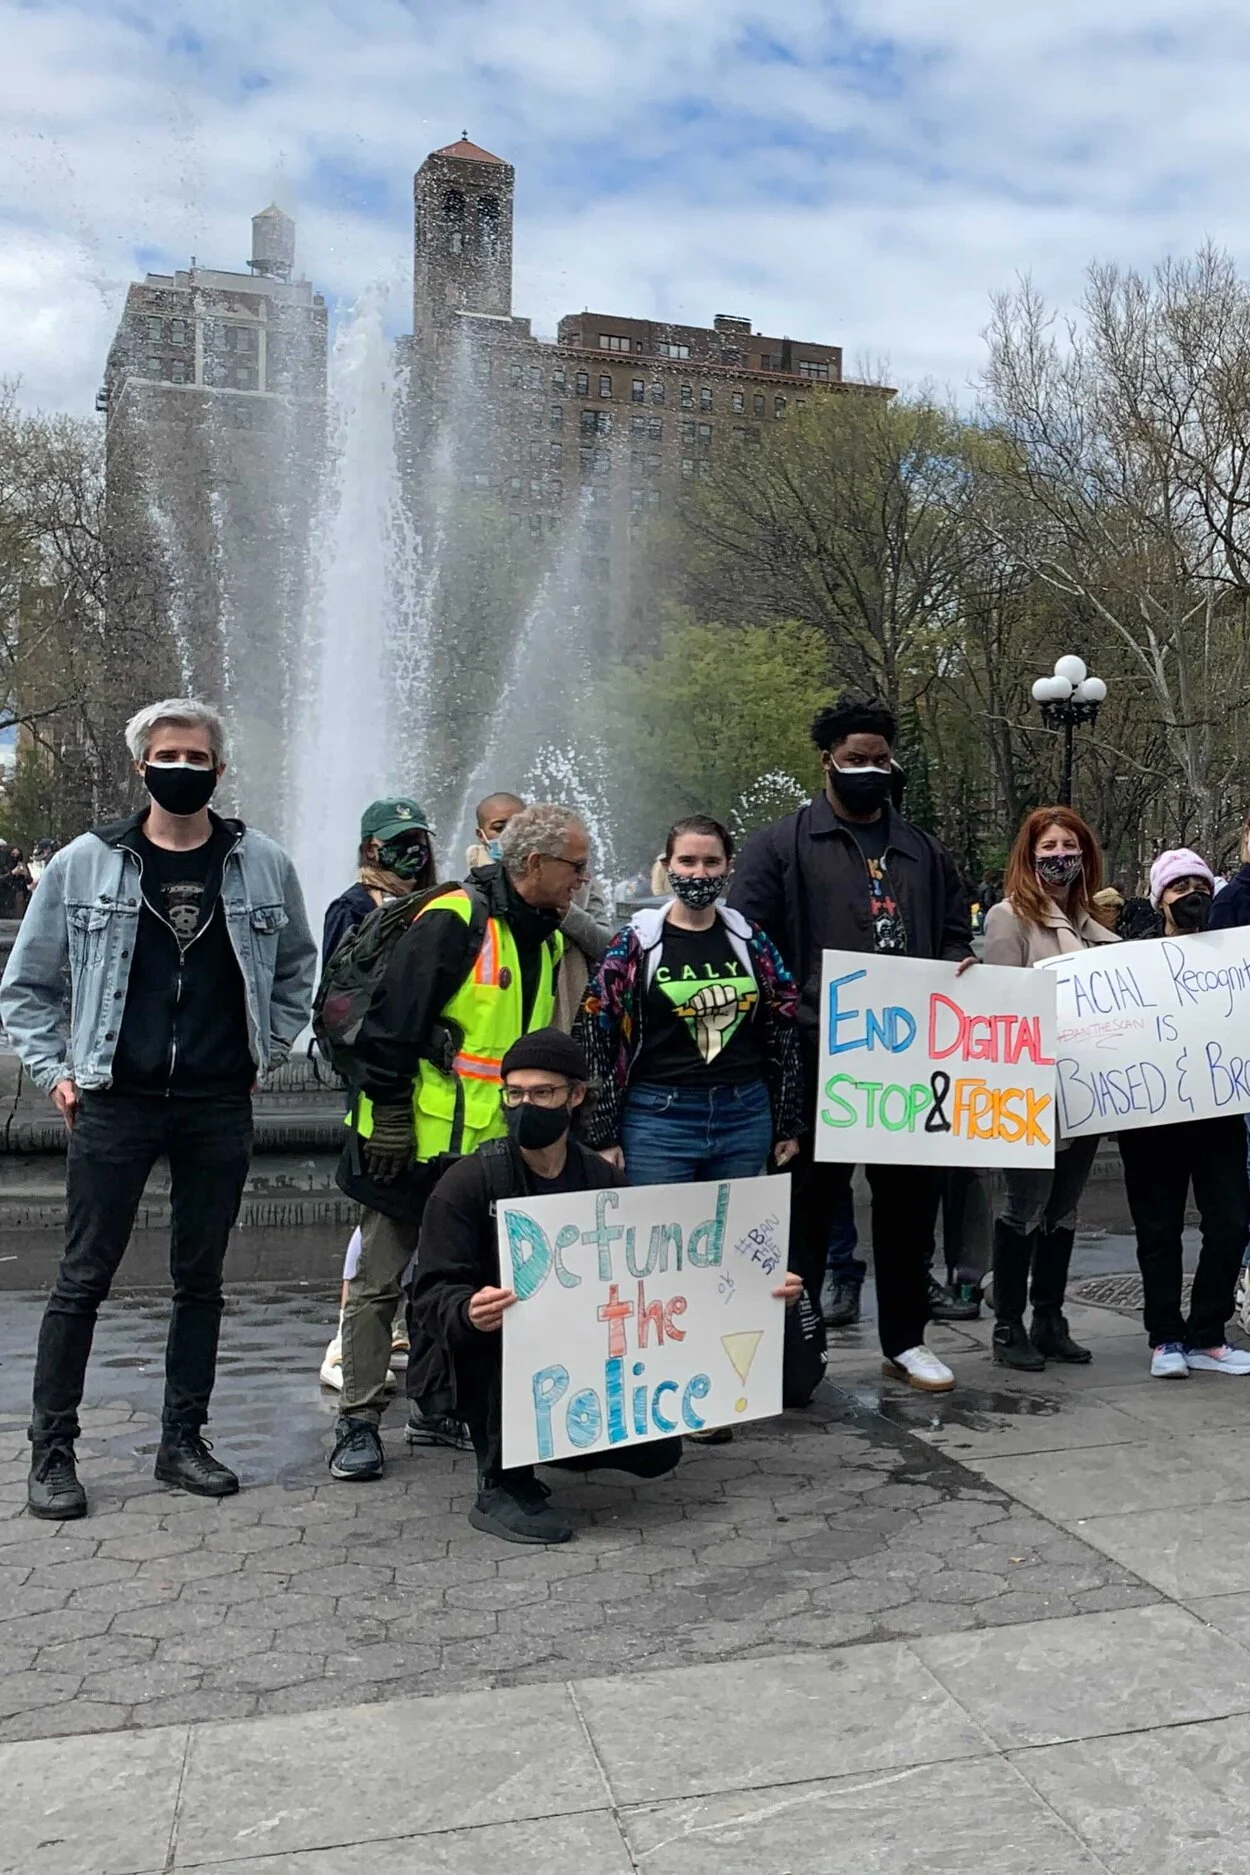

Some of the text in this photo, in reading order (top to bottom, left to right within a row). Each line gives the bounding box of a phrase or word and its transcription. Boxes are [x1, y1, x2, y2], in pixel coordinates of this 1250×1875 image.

[829, 969, 1055, 1065] END DIGITAL
[1156, 1014, 1178, 1042] IS
[1056, 1058, 1167, 1129] BIASED
[504, 1182, 730, 1301] Defund
[597, 1280, 687, 1357] the
